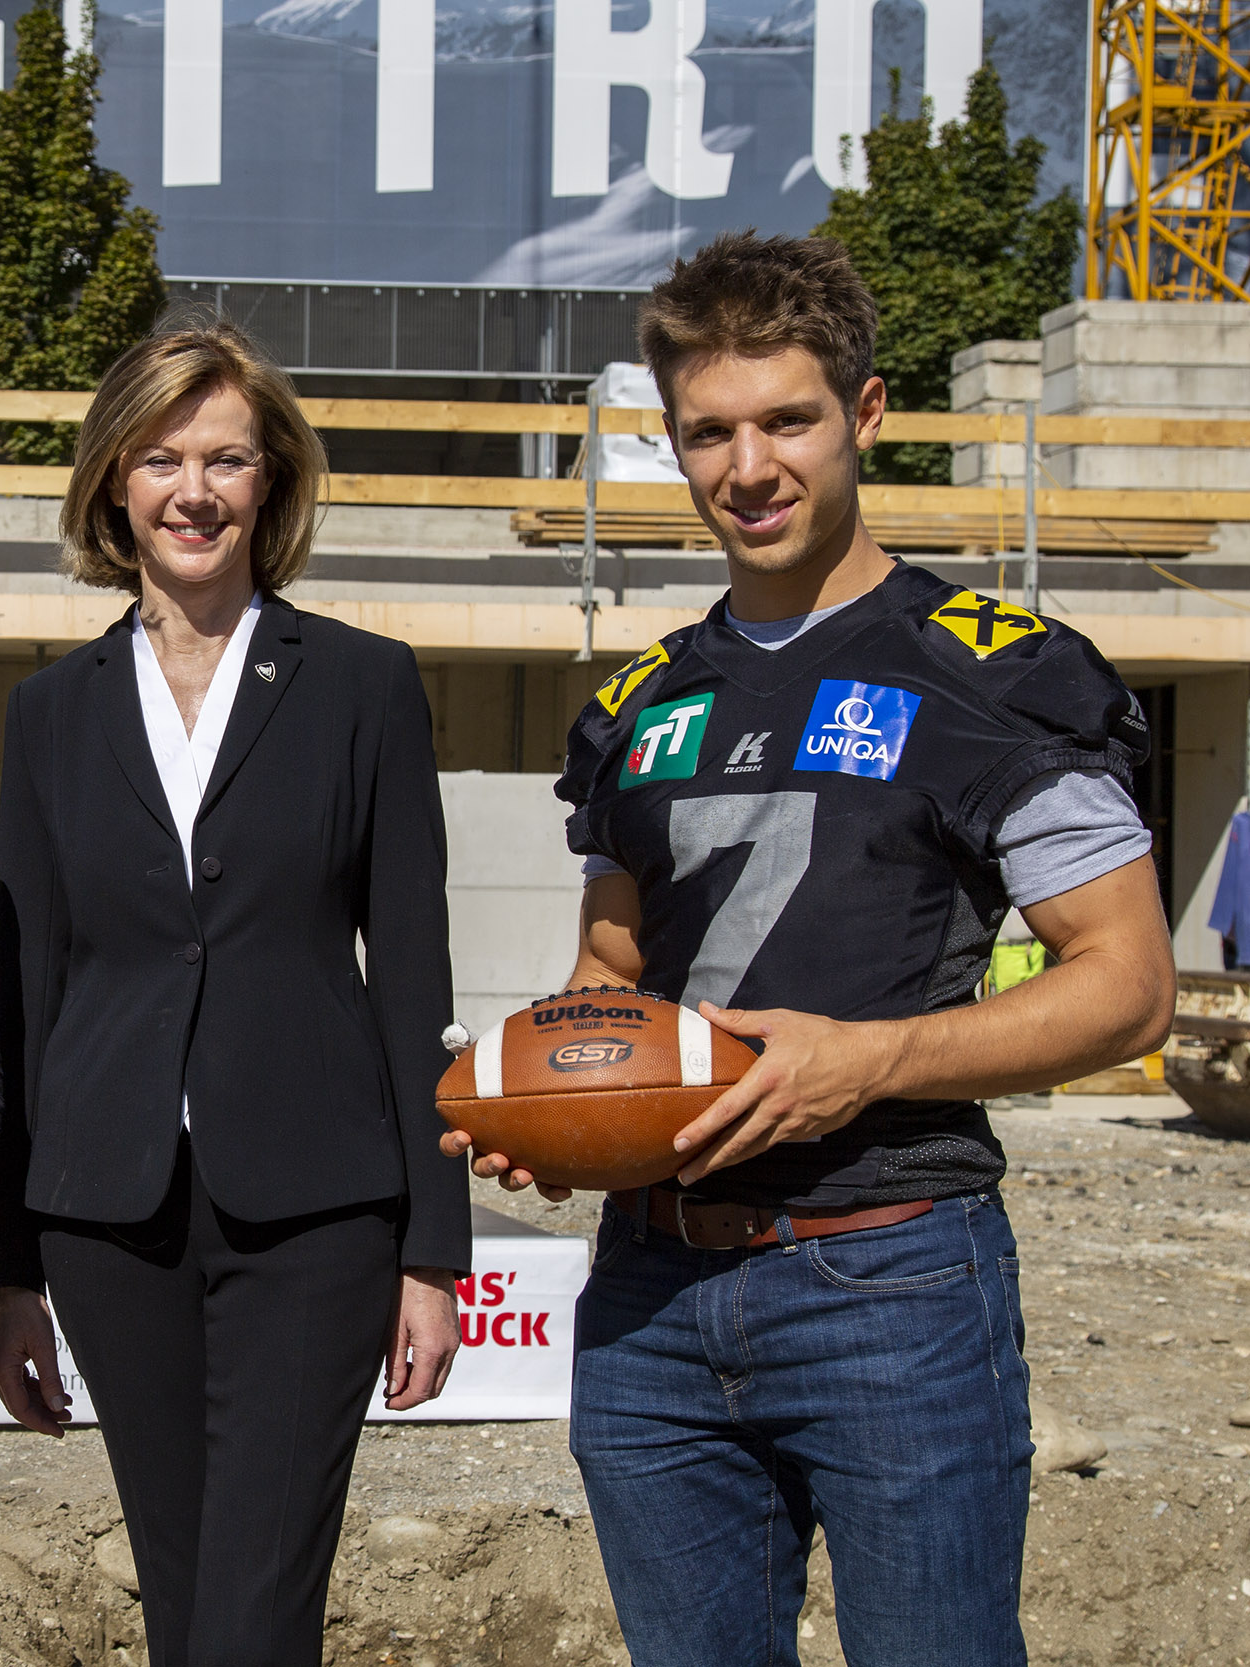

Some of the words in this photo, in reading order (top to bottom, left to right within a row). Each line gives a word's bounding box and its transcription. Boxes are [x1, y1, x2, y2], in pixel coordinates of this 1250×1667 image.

[806, 735, 890, 763] UNIQA
[669, 791, 818, 1010] 7
[533, 1003, 649, 1026] Wilson
[555, 1043, 630, 1064] GST
[460, 1312, 550, 1347] UCK
